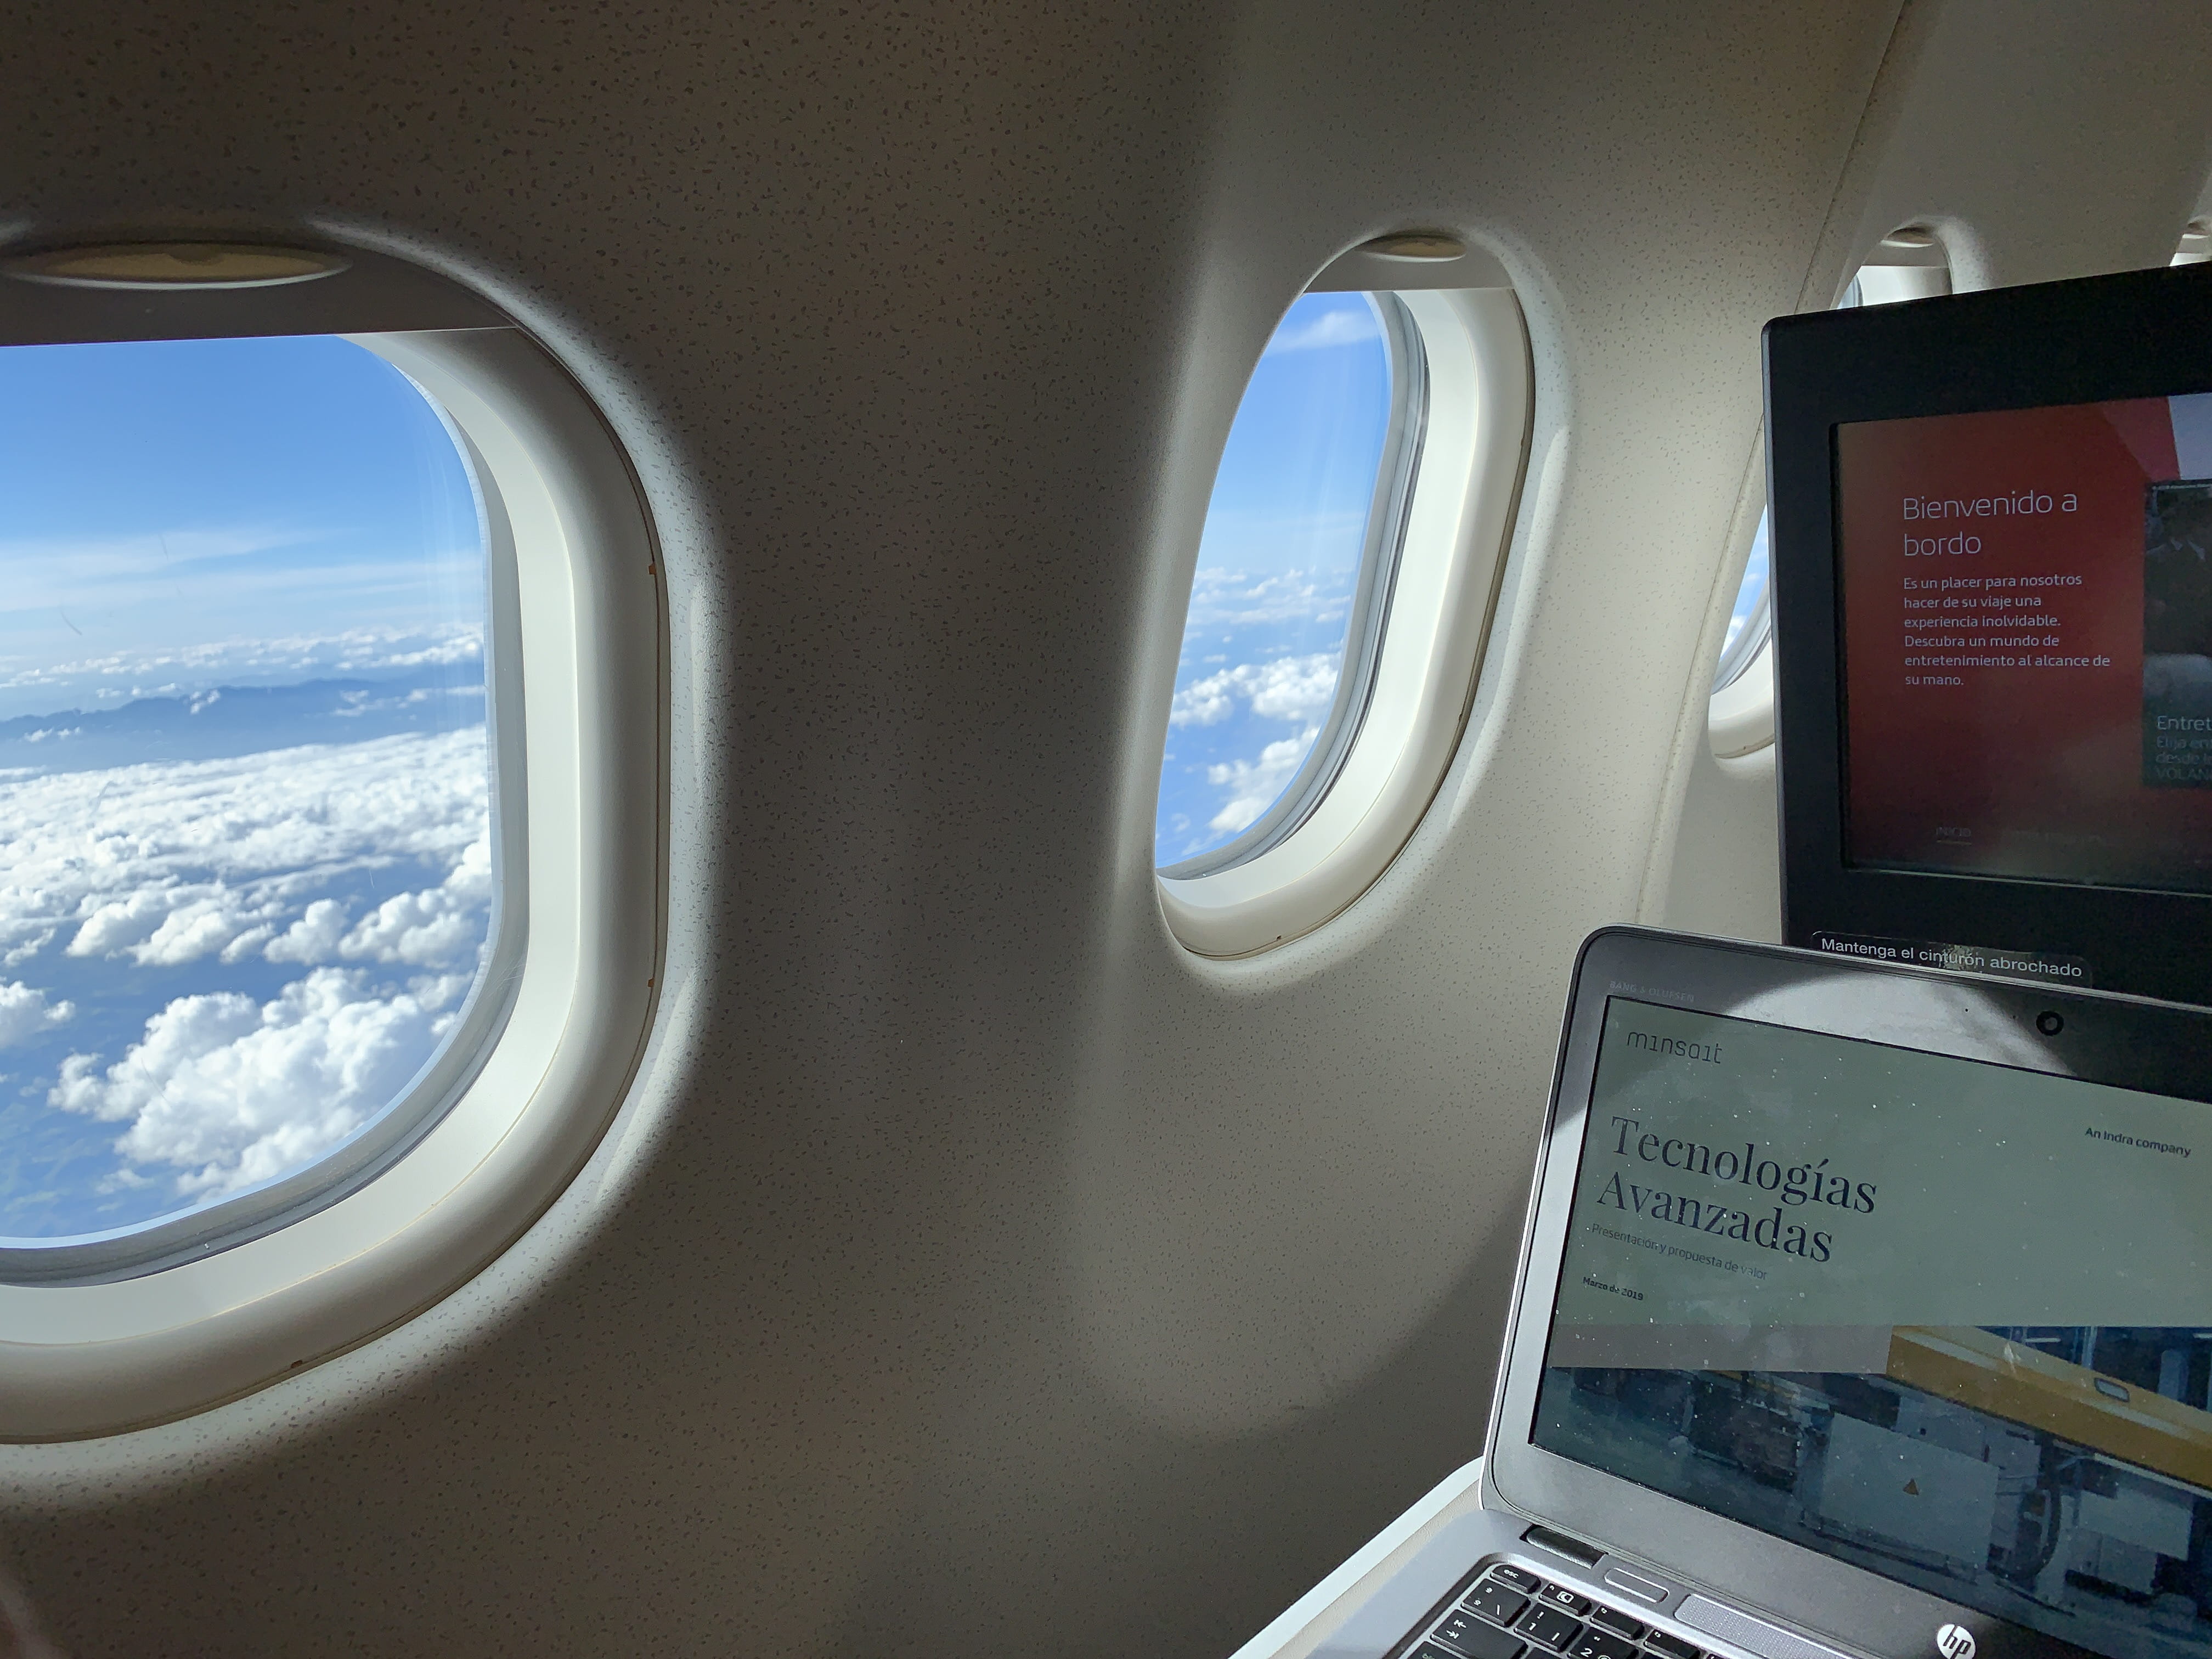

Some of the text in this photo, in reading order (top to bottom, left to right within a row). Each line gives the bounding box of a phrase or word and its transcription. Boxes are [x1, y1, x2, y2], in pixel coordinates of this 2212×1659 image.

[1903, 490, 2078, 520] Bienvenido a
[1904, 531, 1982, 557] bordo
[1904, 574, 2083, 592] Es un placer para nosotros
[1904, 596, 2041, 611] hacer de su viaje una
[1904, 614, 2061, 630] experiencia inolvidable.
[1905, 635, 2059, 647] Descubra un mundo de
[1904, 654, 2111, 667] entretenimiento al alcance de
[1905, 676, 1964, 686] su mano.
[1821, 938, 2083, 977] Mantenga el cinturón abrochado
[1609, 980, 1637, 993] BANG
[1649, 987, 1695, 1003] OLUFSEN
[1627, 1031, 1723, 1065] minsait
[2085, 1127, 2192, 1159] An Indra company
[1611, 1115, 1877, 1214] Tecnologías
[1596, 1171, 1833, 1263] Avanzadas
[1592, 1223, 1768, 1281] Presentación y propuesta de valor
[1583, 1276, 1644, 1301] Marzo de 2019
[1503, 1569, 1519, 1579] esc
[1528, 1622, 1537, 1631] 1
[1580, 1647, 1593, 1658] 2
[1942, 1624, 1972, 1659] hp
